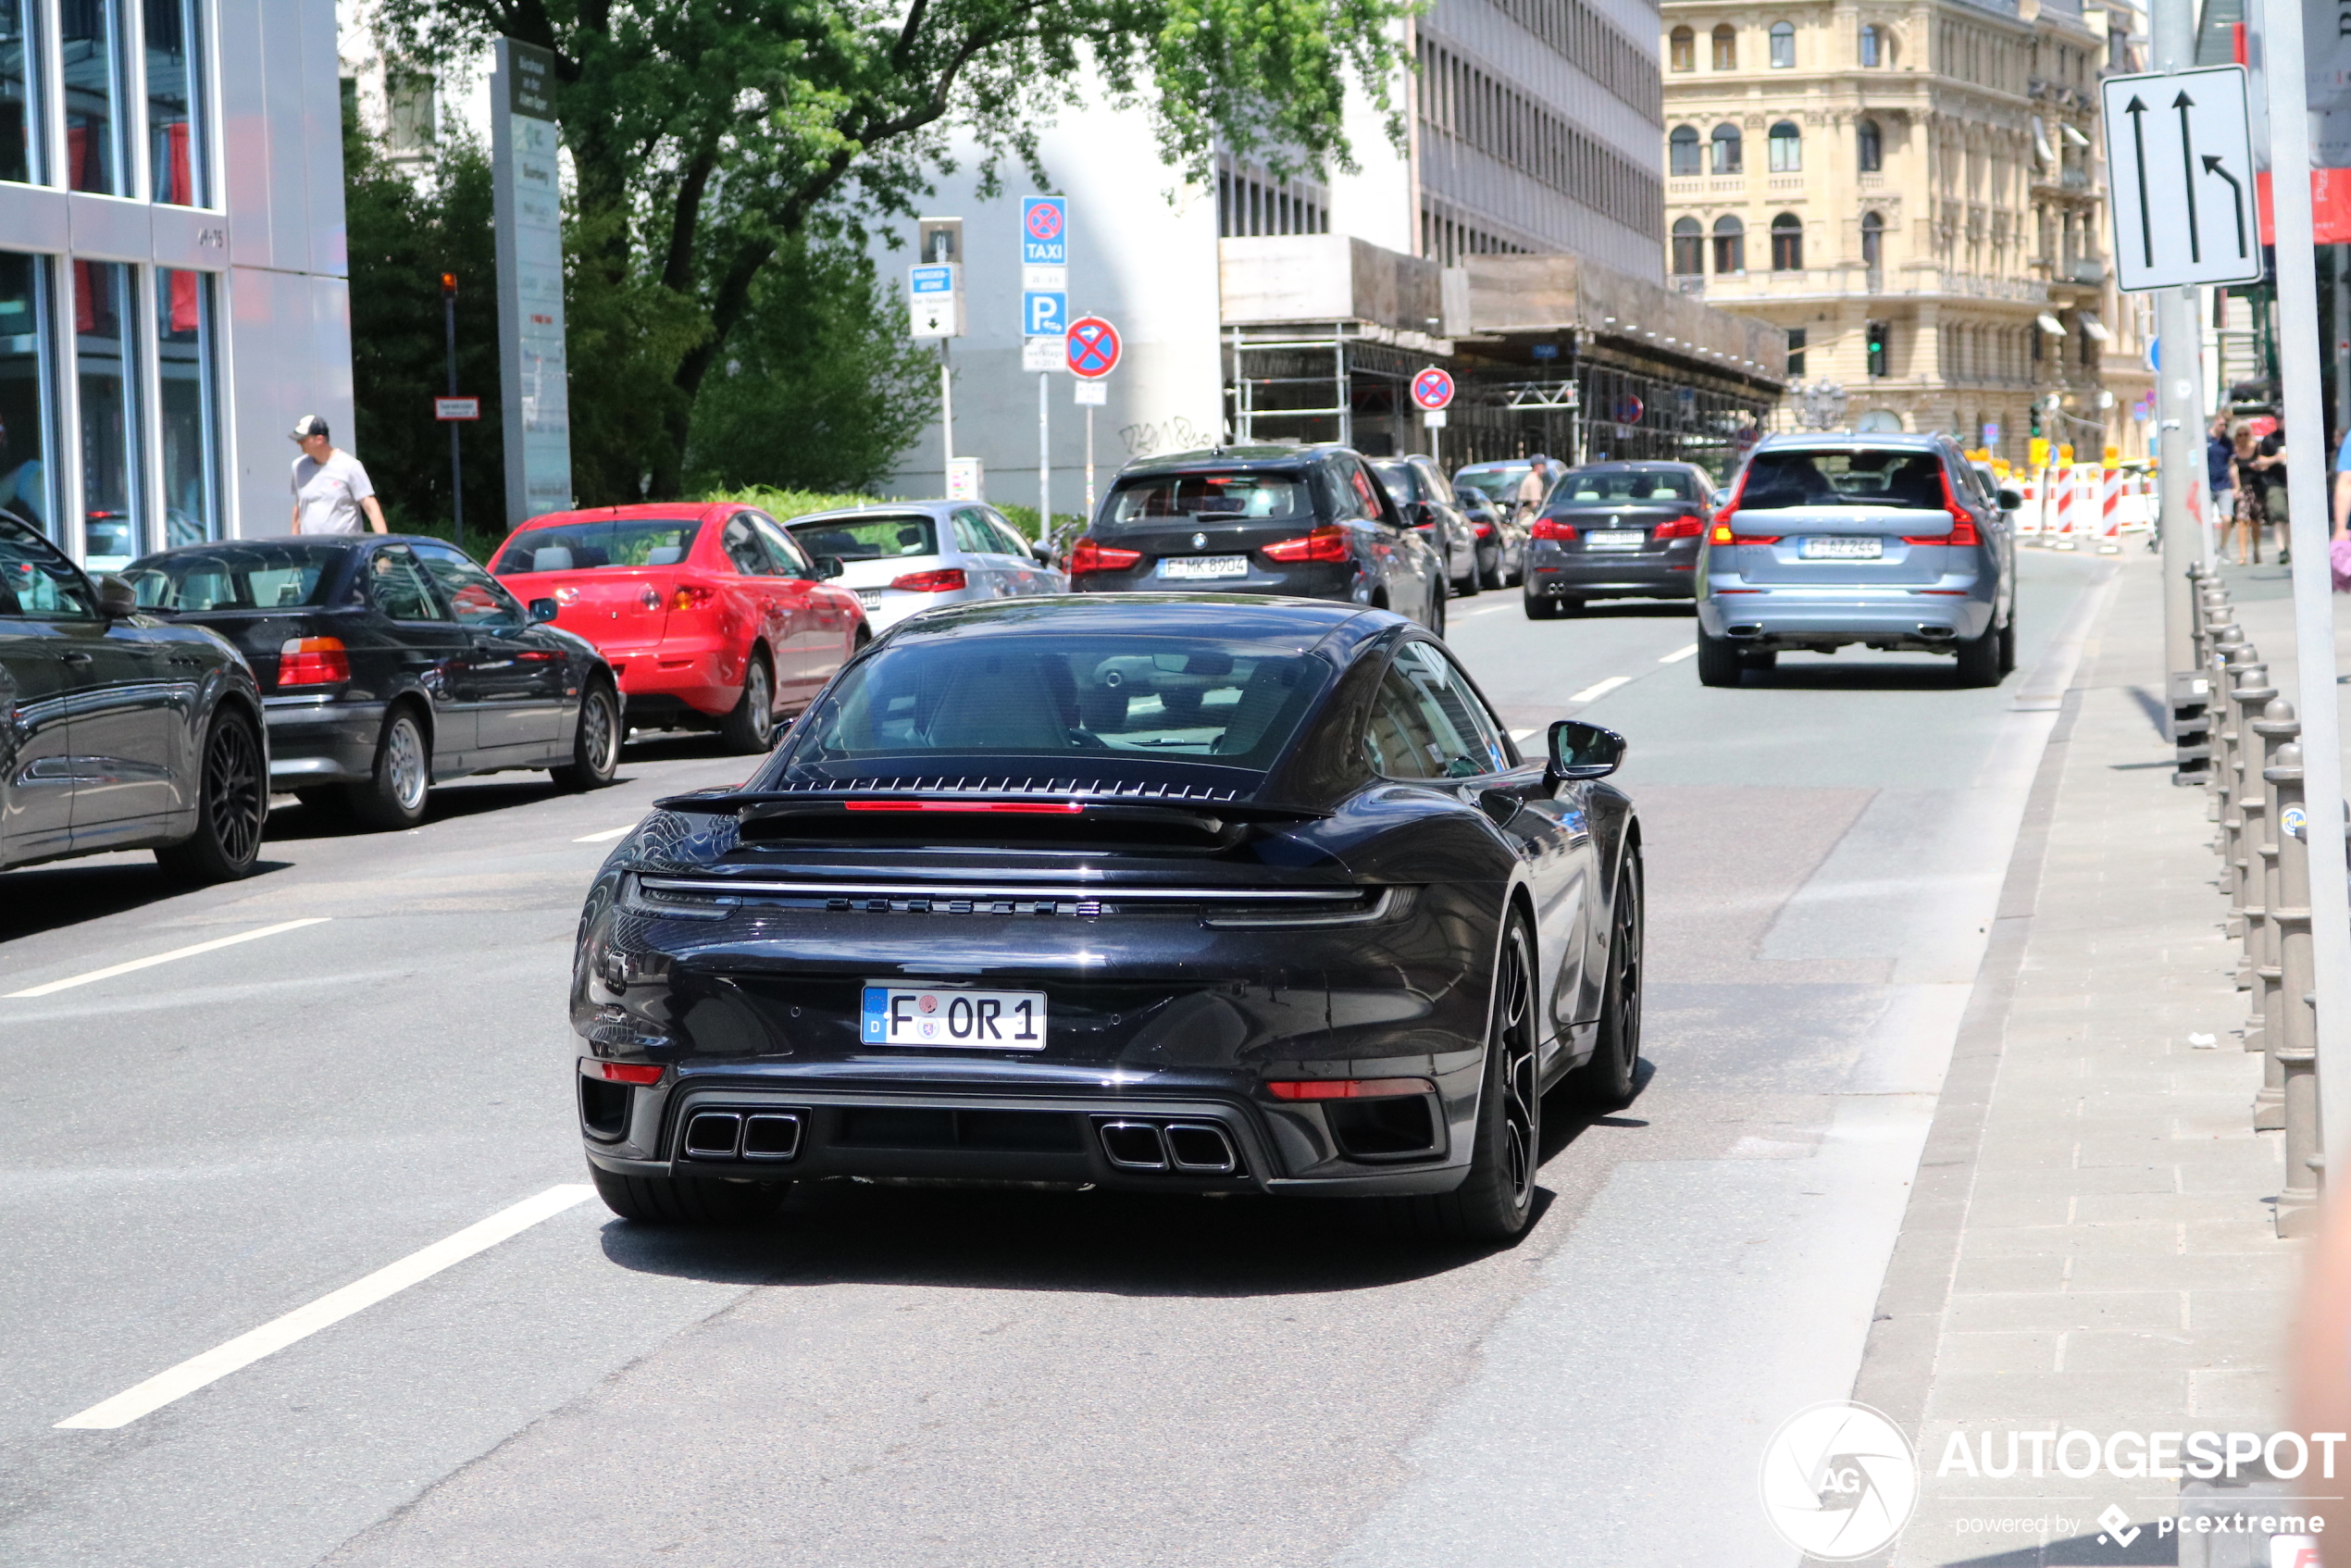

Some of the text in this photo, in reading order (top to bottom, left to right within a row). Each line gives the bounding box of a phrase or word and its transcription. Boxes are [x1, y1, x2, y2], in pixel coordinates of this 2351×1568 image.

[1026, 243, 1063, 259] TAXI
[1032, 295, 1058, 331] P
[1810, 540, 1874, 553] F AZ 244
[1168, 557, 1244, 573] F MK 8904
[827, 898, 1101, 916] PORSCHE
[891, 995, 1038, 1039] F OR 1
[870, 1020, 880, 1033] D
